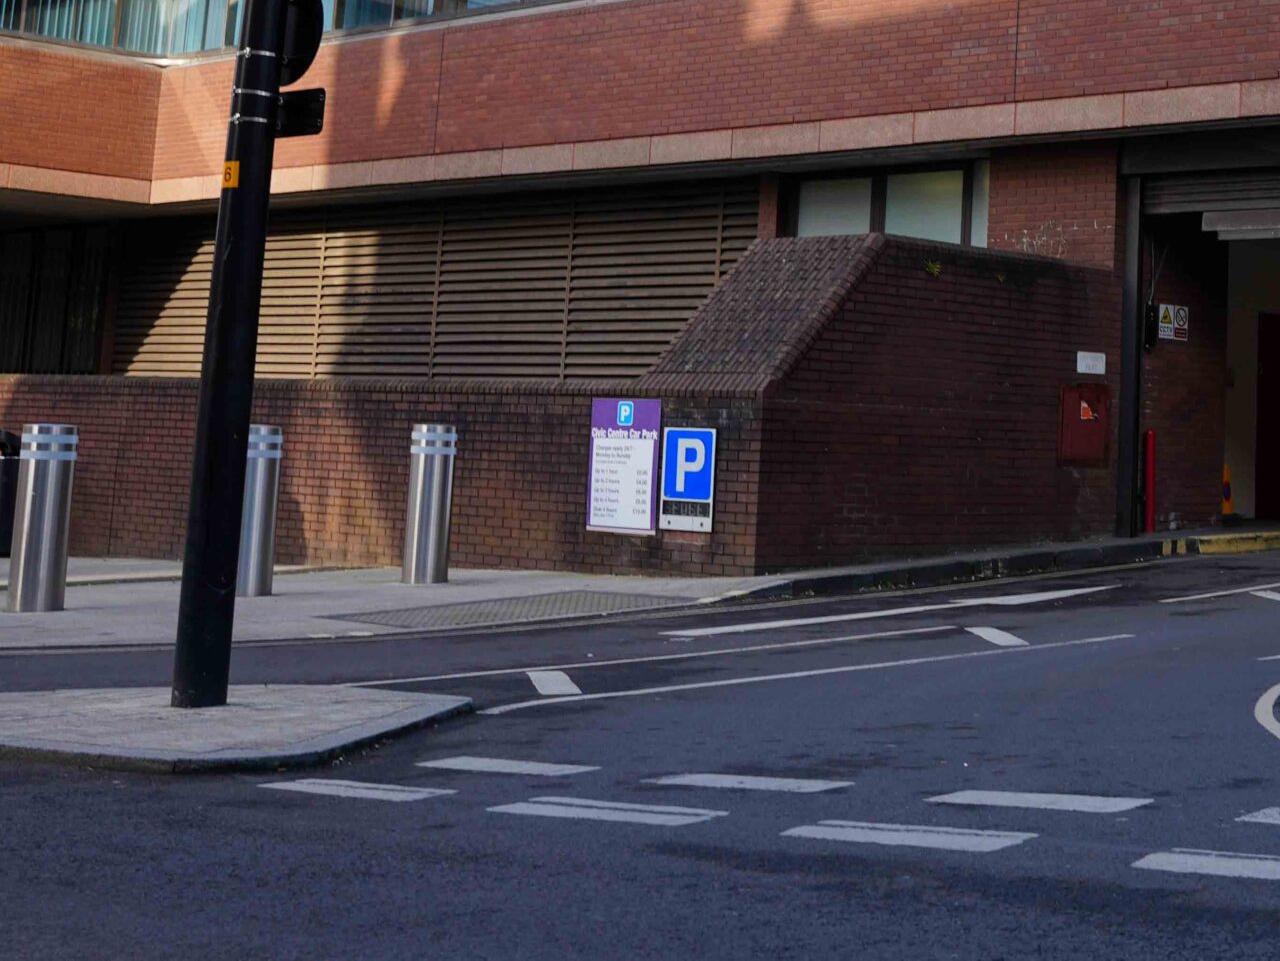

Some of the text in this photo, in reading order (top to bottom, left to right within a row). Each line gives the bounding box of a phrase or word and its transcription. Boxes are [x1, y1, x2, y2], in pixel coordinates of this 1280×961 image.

[620, 405, 630, 422] P
[591, 427, 658, 441] Civic Centre Car Park
[675, 437, 706, 493] P
